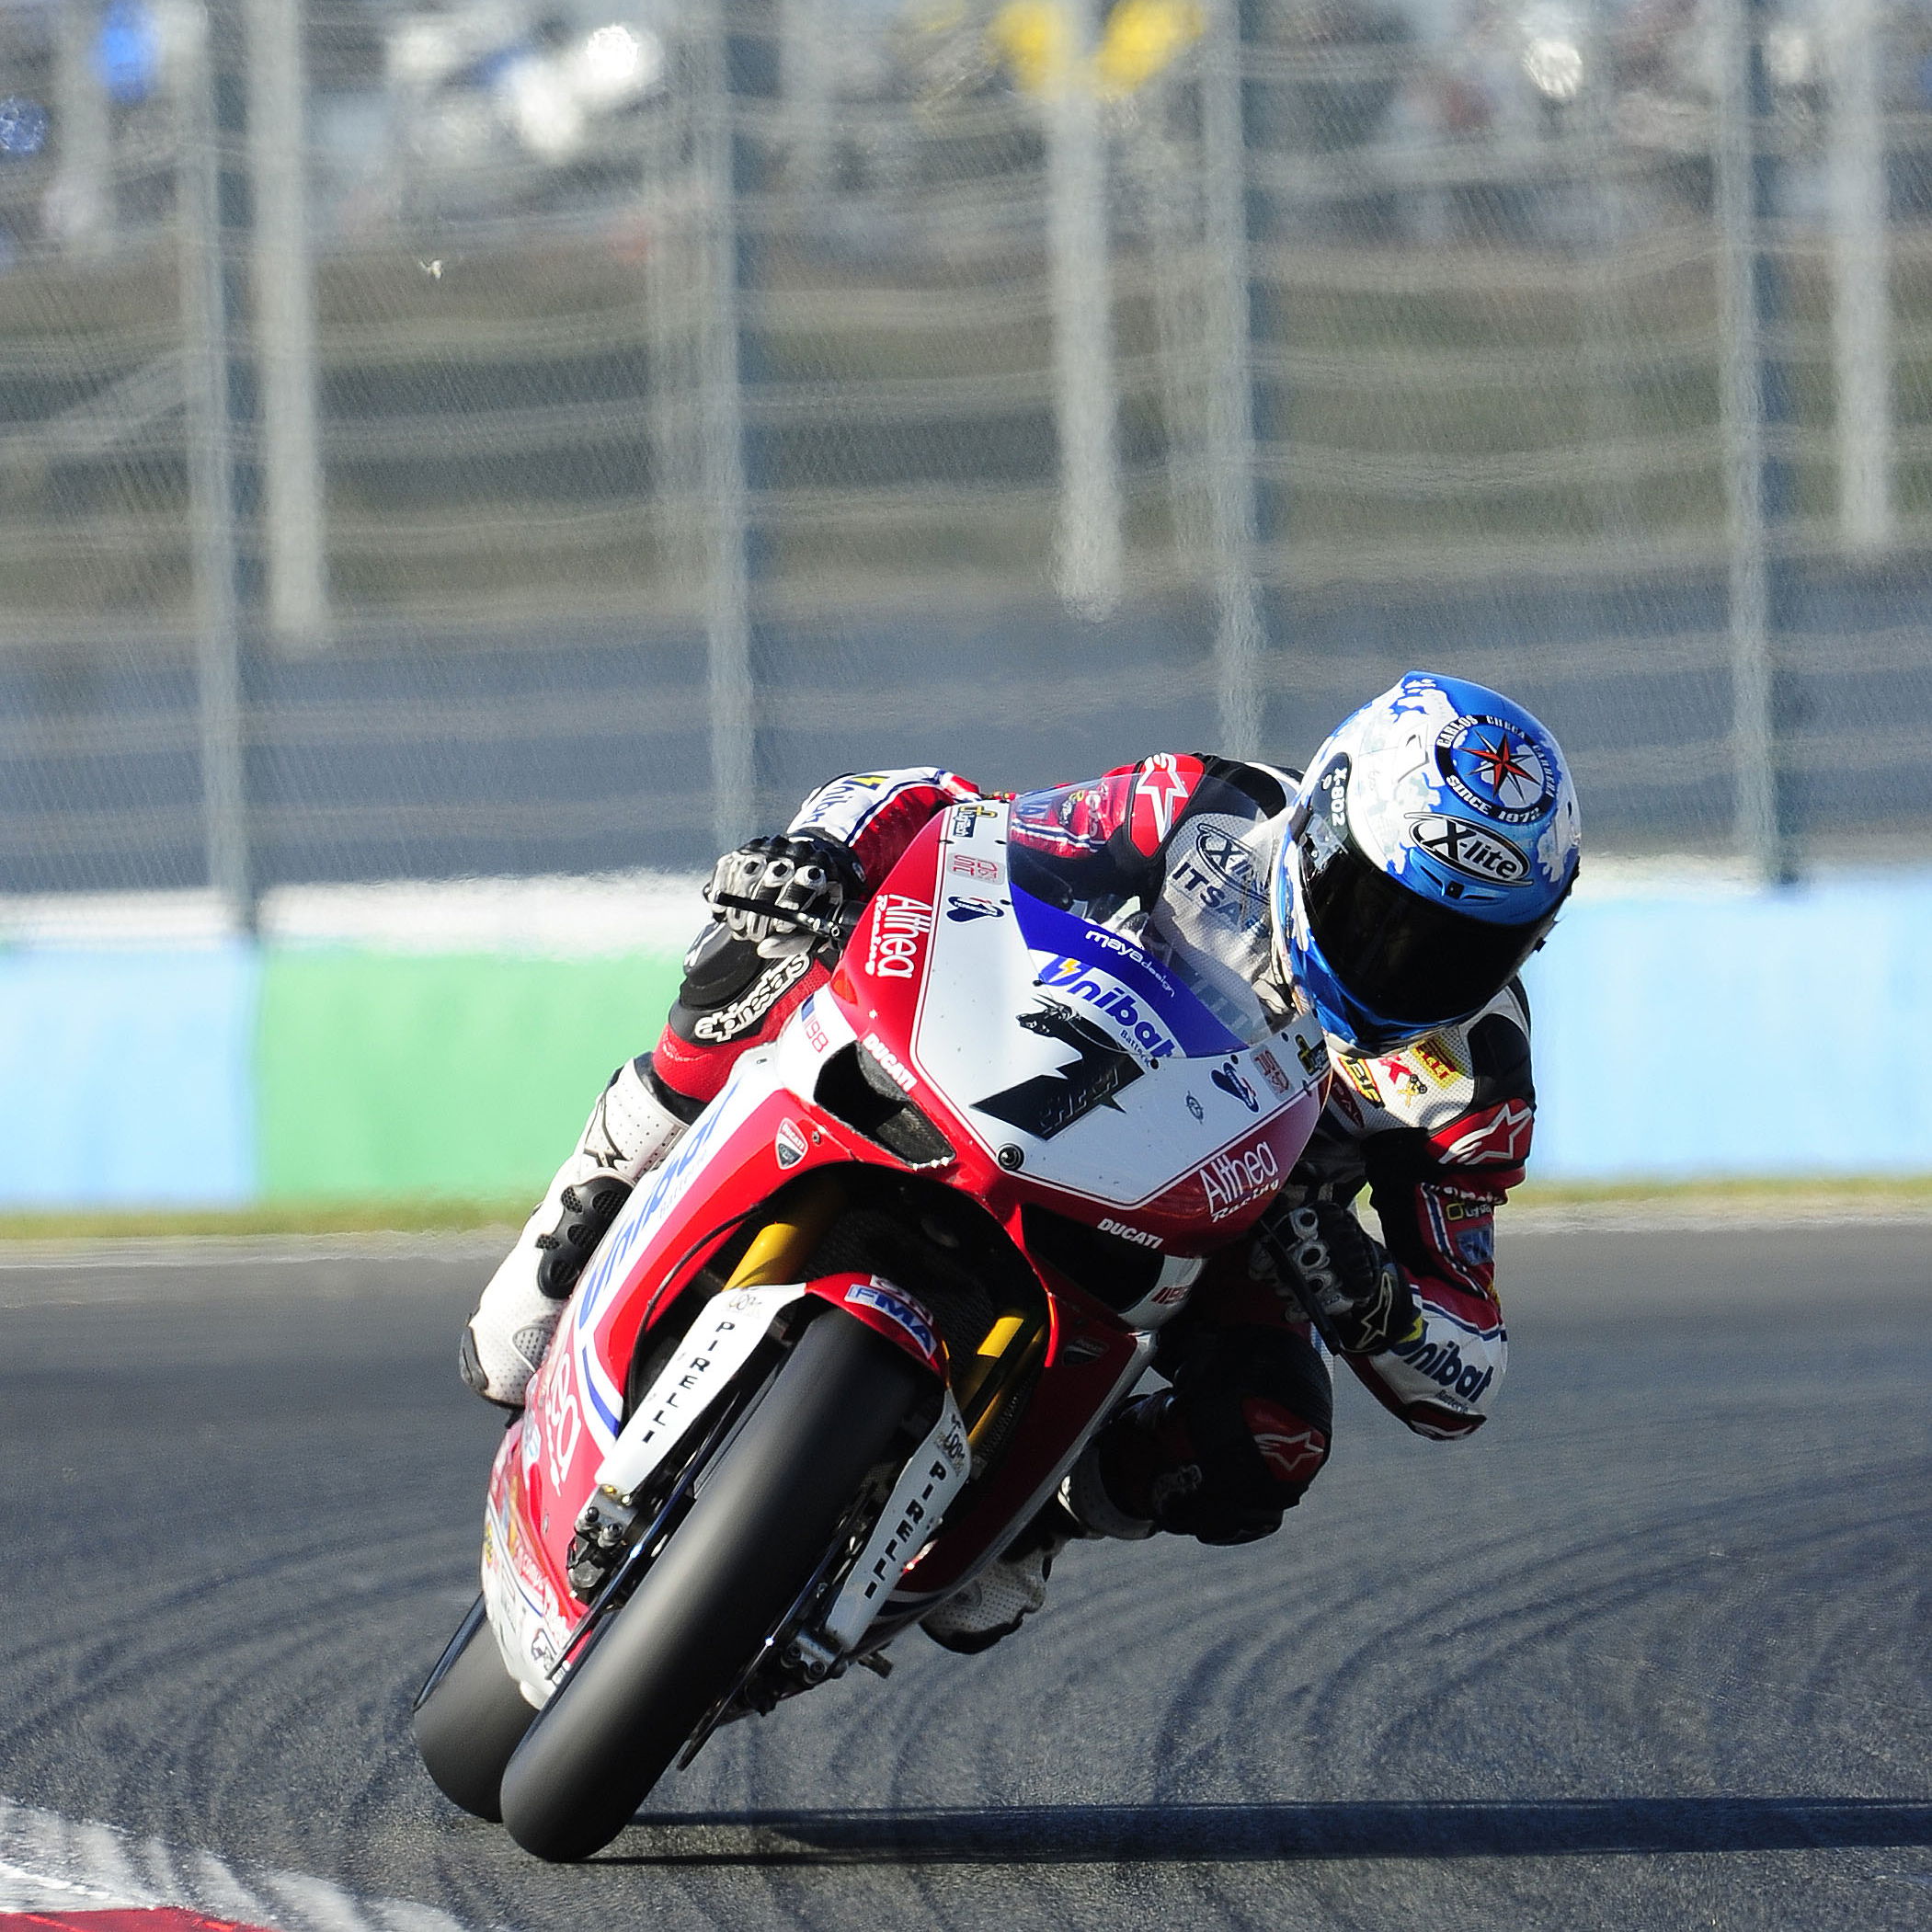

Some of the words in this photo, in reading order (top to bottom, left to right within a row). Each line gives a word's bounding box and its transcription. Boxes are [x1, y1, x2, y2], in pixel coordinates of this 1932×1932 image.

[1436, 714, 1478, 748] CARLOS
[1331, 768, 1348, 826] X-802
[1446, 774, 1492, 815] SINCE
[1498, 807, 1539, 823] 1972
[1422, 818, 1517, 878] X-lite
[876, 895, 932, 977] Althea
[863, 1032, 918, 1093] DUCATI
[1200, 1141, 1278, 1214] Althea
[1212, 1178, 1279, 1223] Racing
[1097, 1218, 1163, 1249] DUCATI
[642, 1321, 736, 1444] PIRELLI
[864, 1459, 947, 1600] PIRELLI
